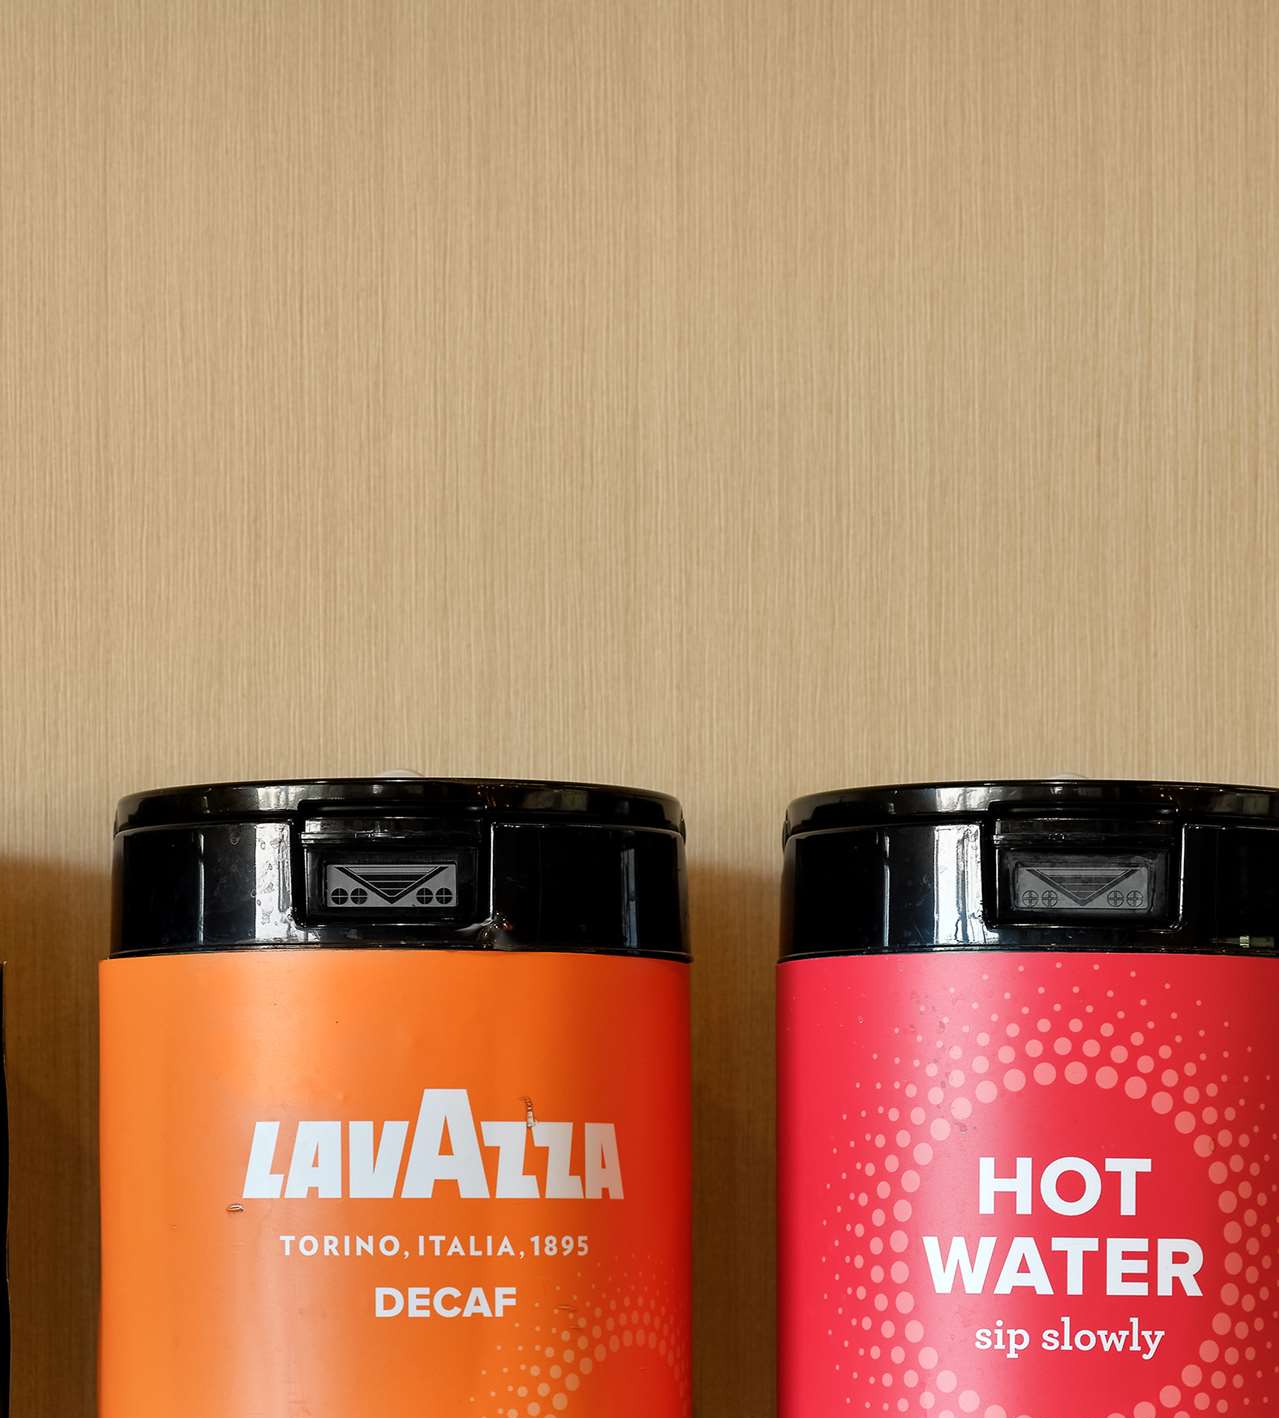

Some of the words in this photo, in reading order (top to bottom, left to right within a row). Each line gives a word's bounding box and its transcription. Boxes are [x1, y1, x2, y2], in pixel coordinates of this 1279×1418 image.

[242, 1089, 624, 1199] LAVAZZA
[979, 1156, 1152, 1216] HOT
[531, 1235, 589, 1257] 1895
[922, 1238, 1204, 1297] WATER
[375, 1287, 517, 1318] DECAF
[975, 1319, 1030, 1358] sip
[1041, 1317, 1165, 1359] slowly
